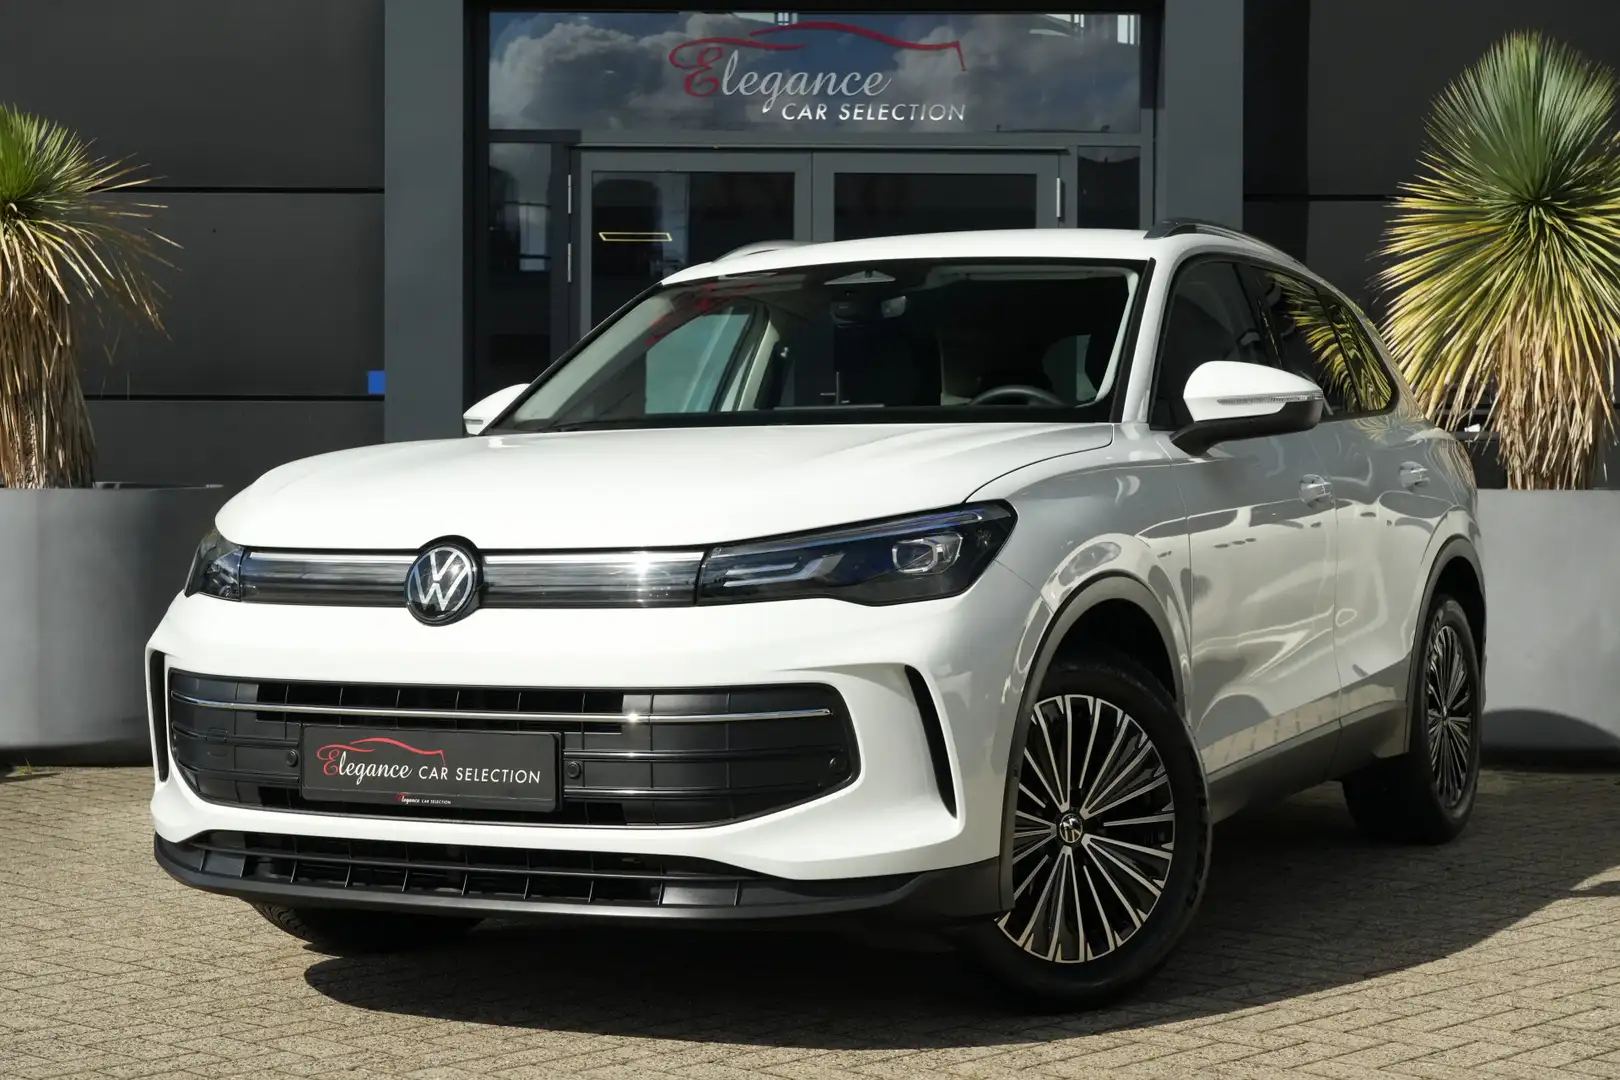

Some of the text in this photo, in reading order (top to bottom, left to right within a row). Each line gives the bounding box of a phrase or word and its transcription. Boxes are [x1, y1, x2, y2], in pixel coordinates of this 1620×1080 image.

[669, 37, 891, 113] Elegance
[781, 103, 966, 121] CAR SELECTION
[317, 745, 541, 785] Elegance CAR SELECTION
